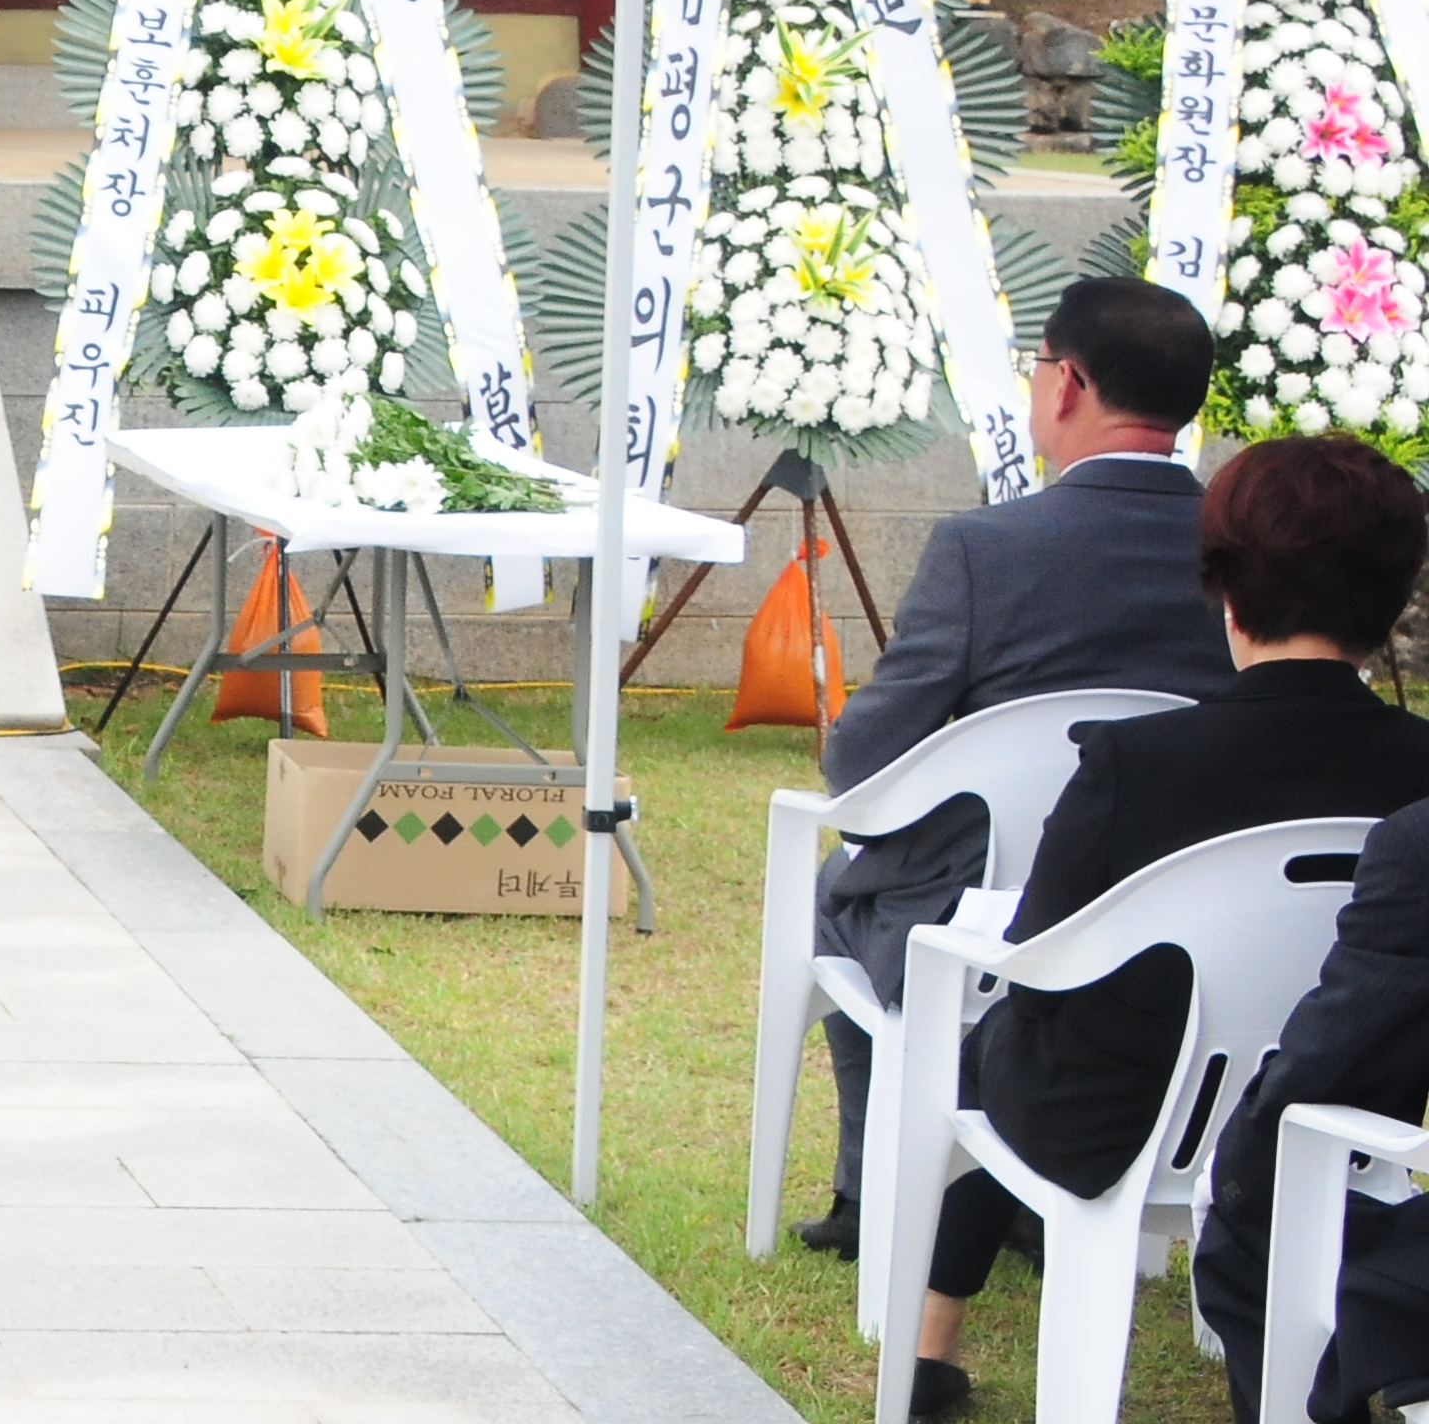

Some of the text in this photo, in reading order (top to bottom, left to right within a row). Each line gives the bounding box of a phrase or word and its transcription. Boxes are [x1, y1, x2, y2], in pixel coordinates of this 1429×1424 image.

[59, 281, 120, 447] 피우진
[377, 782, 566, 803] FLORAL FOAM
